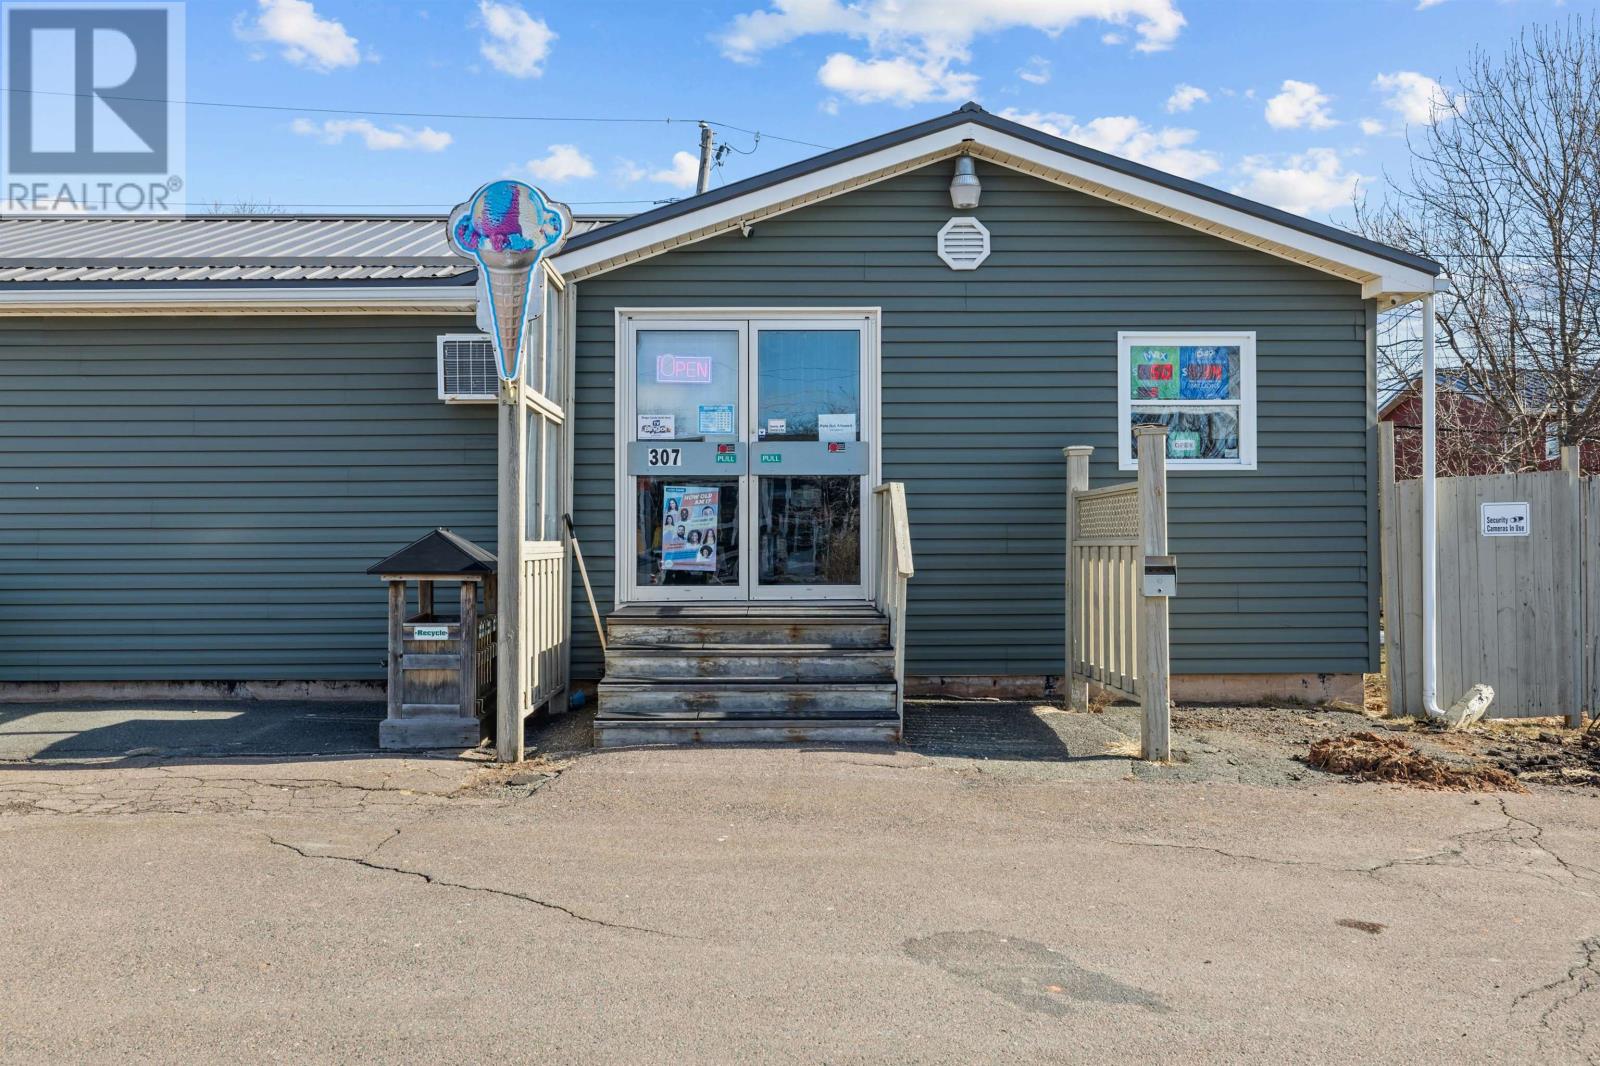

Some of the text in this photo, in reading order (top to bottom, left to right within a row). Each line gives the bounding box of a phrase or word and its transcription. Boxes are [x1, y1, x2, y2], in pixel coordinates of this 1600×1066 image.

[649, 449, 680, 466] 307
[717, 455, 735, 463] PULL
[762, 455, 780, 463] PULL
[1486, 516, 1508, 524] Security
